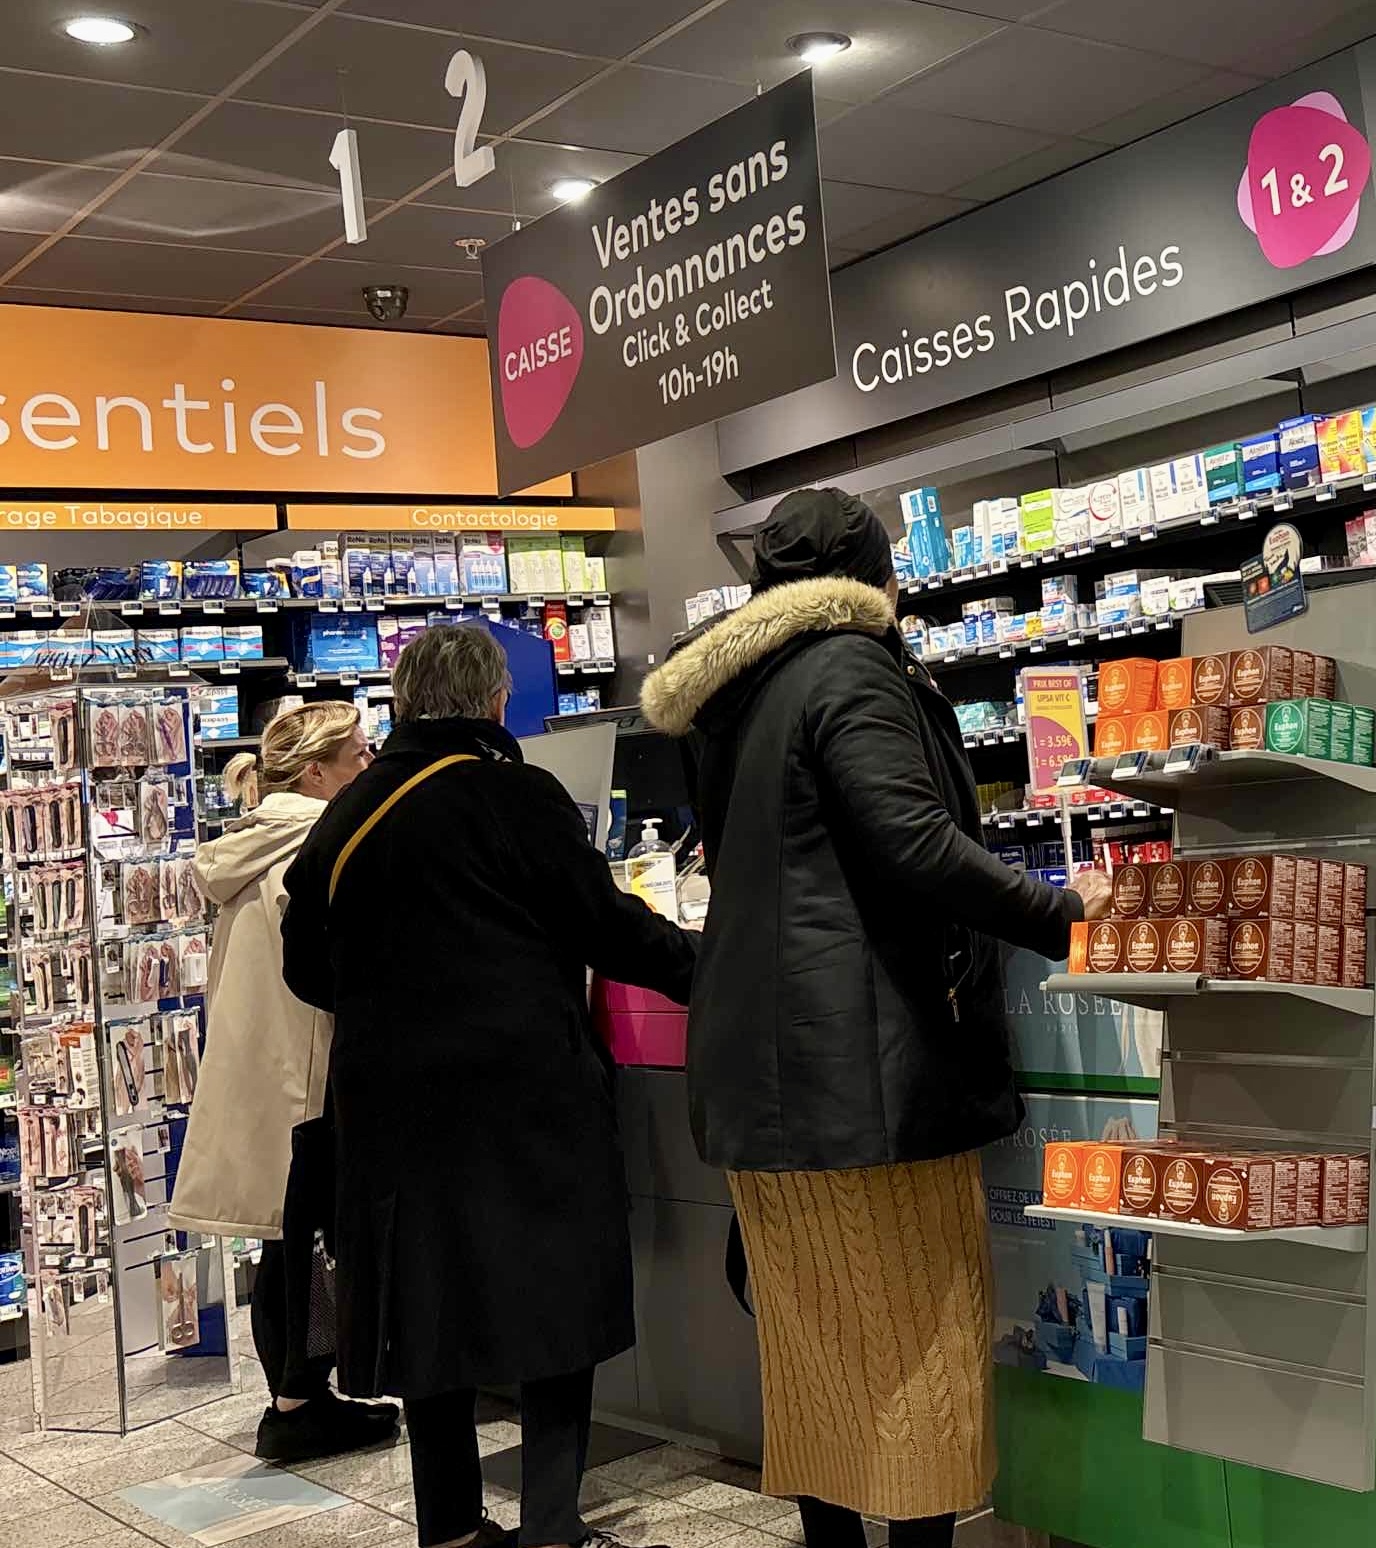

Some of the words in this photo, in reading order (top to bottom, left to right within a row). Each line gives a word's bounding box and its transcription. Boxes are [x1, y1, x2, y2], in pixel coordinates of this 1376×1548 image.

[444, 50, 495, 187] 2
[329, 129, 367, 243] 1
[592, 186, 700, 269] Ventes
[708, 140, 789, 213] sans
[1262, 167, 1282, 216] 1
[1290, 172, 1315, 208] &
[1319, 144, 1349, 196] 2
[589, 205, 806, 335] Ordonnances
[504, 326, 573, 384] CAISSE
[622, 322, 671, 367] Click
[675, 313, 691, 346] &
[695, 279, 774, 336] Collect
[851, 313, 996, 393] Caisses
[1004, 243, 1185, 343] Rapides
[658, 347, 740, 405] 10h-19h
[0, 379, 386, 460] entiels
[64, 505, 202, 529] Tabagique
[412, 508, 558, 529] Contactologie
